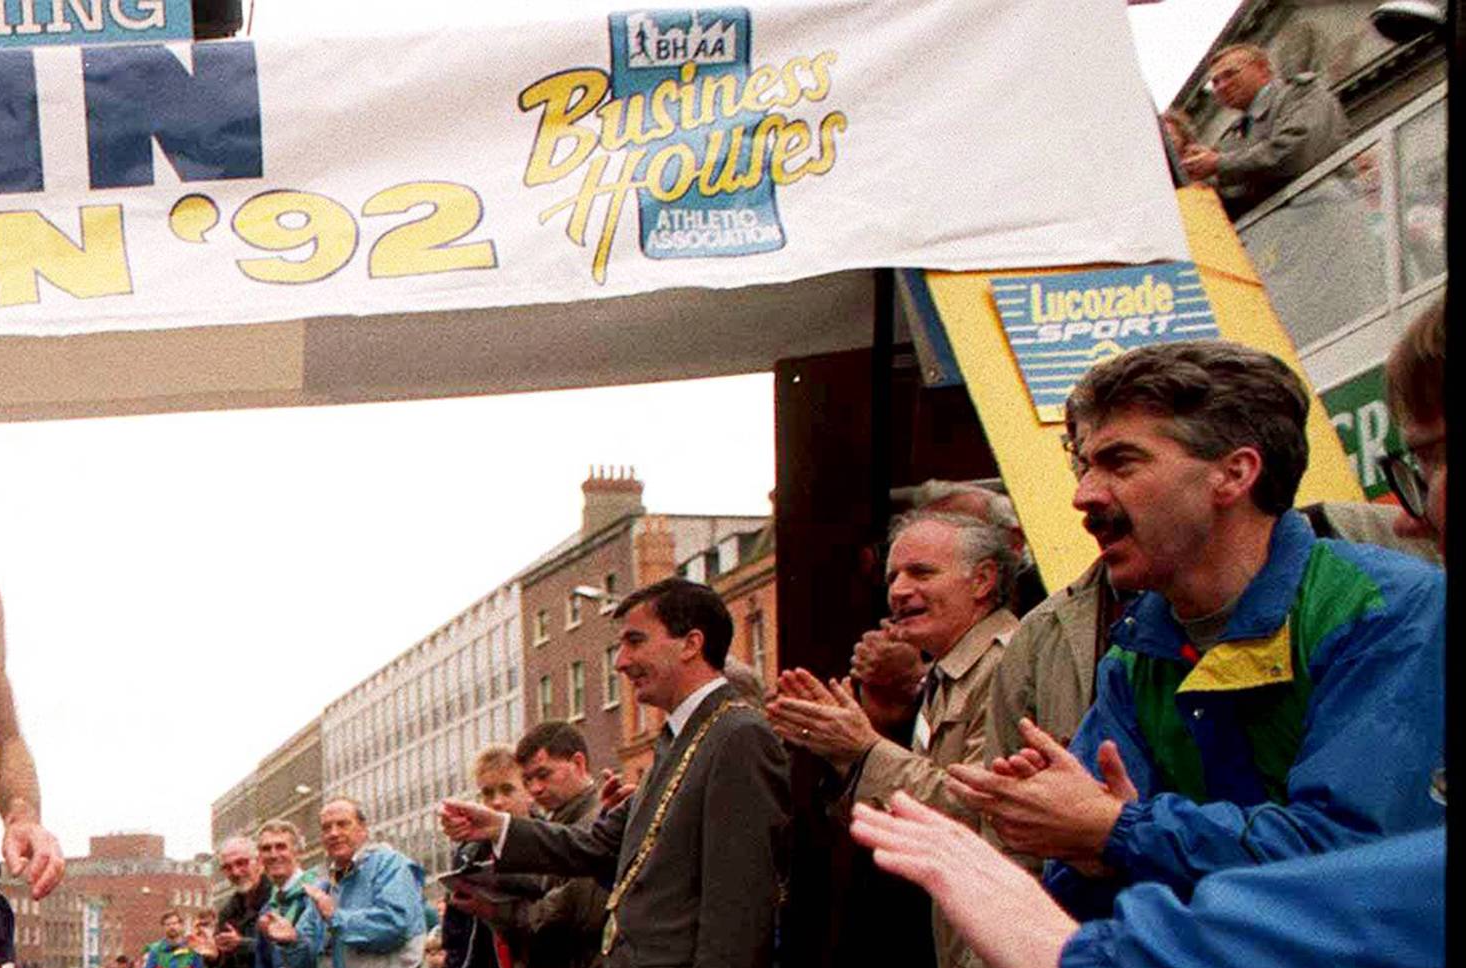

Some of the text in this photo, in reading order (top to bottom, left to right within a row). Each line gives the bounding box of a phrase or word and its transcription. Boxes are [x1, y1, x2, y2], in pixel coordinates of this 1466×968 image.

[518, 52, 838, 187] Business
[538, 110, 848, 285] Houses
[656, 208, 759, 231] ATHLETIC
[168, 181, 498, 284] '92
[646, 224, 782, 250] ASSOCIATION
[1030, 274, 1175, 324] Lucozade
[1034, 313, 1176, 343] SPORT
